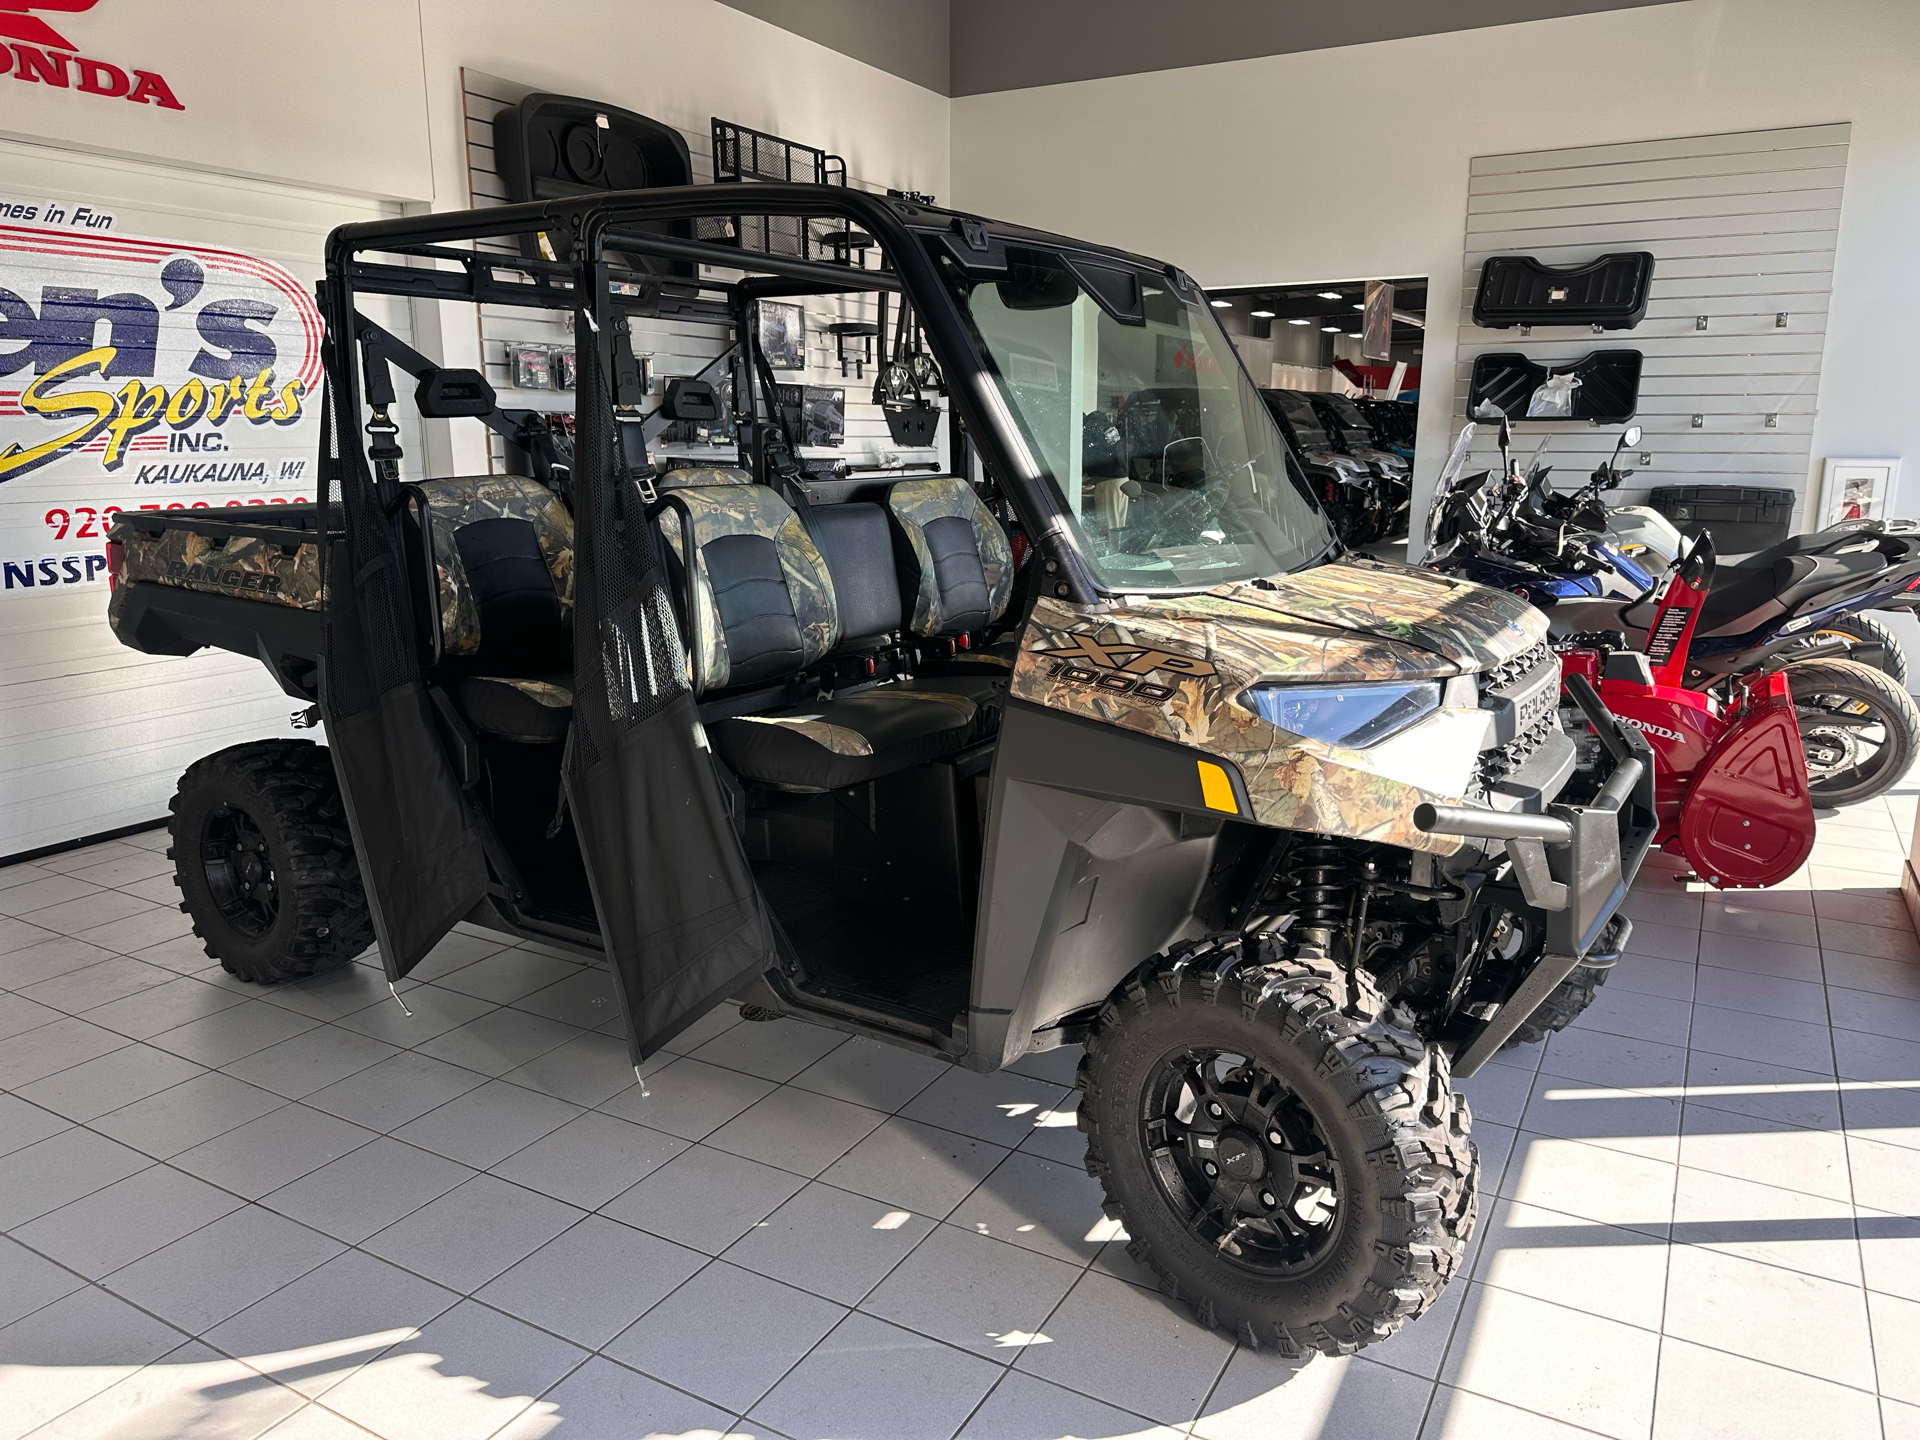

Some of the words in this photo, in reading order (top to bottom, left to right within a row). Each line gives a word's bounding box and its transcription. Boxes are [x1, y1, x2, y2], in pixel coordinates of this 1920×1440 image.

[0, 42, 186, 112] NDA
[43, 203, 65, 223] in
[70, 207, 113, 229] Fun
[0, 346, 307, 482] Sports
[169, 432, 229, 453] INC.
[134, 462, 270, 485] KAUKAUNA,
[279, 461, 306, 480] WI
[165, 560, 282, 594] RANGER
[1028, 631, 1219, 677] XP
[1045, 661, 1177, 701] 1000
[1611, 712, 1687, 744] HONDA
